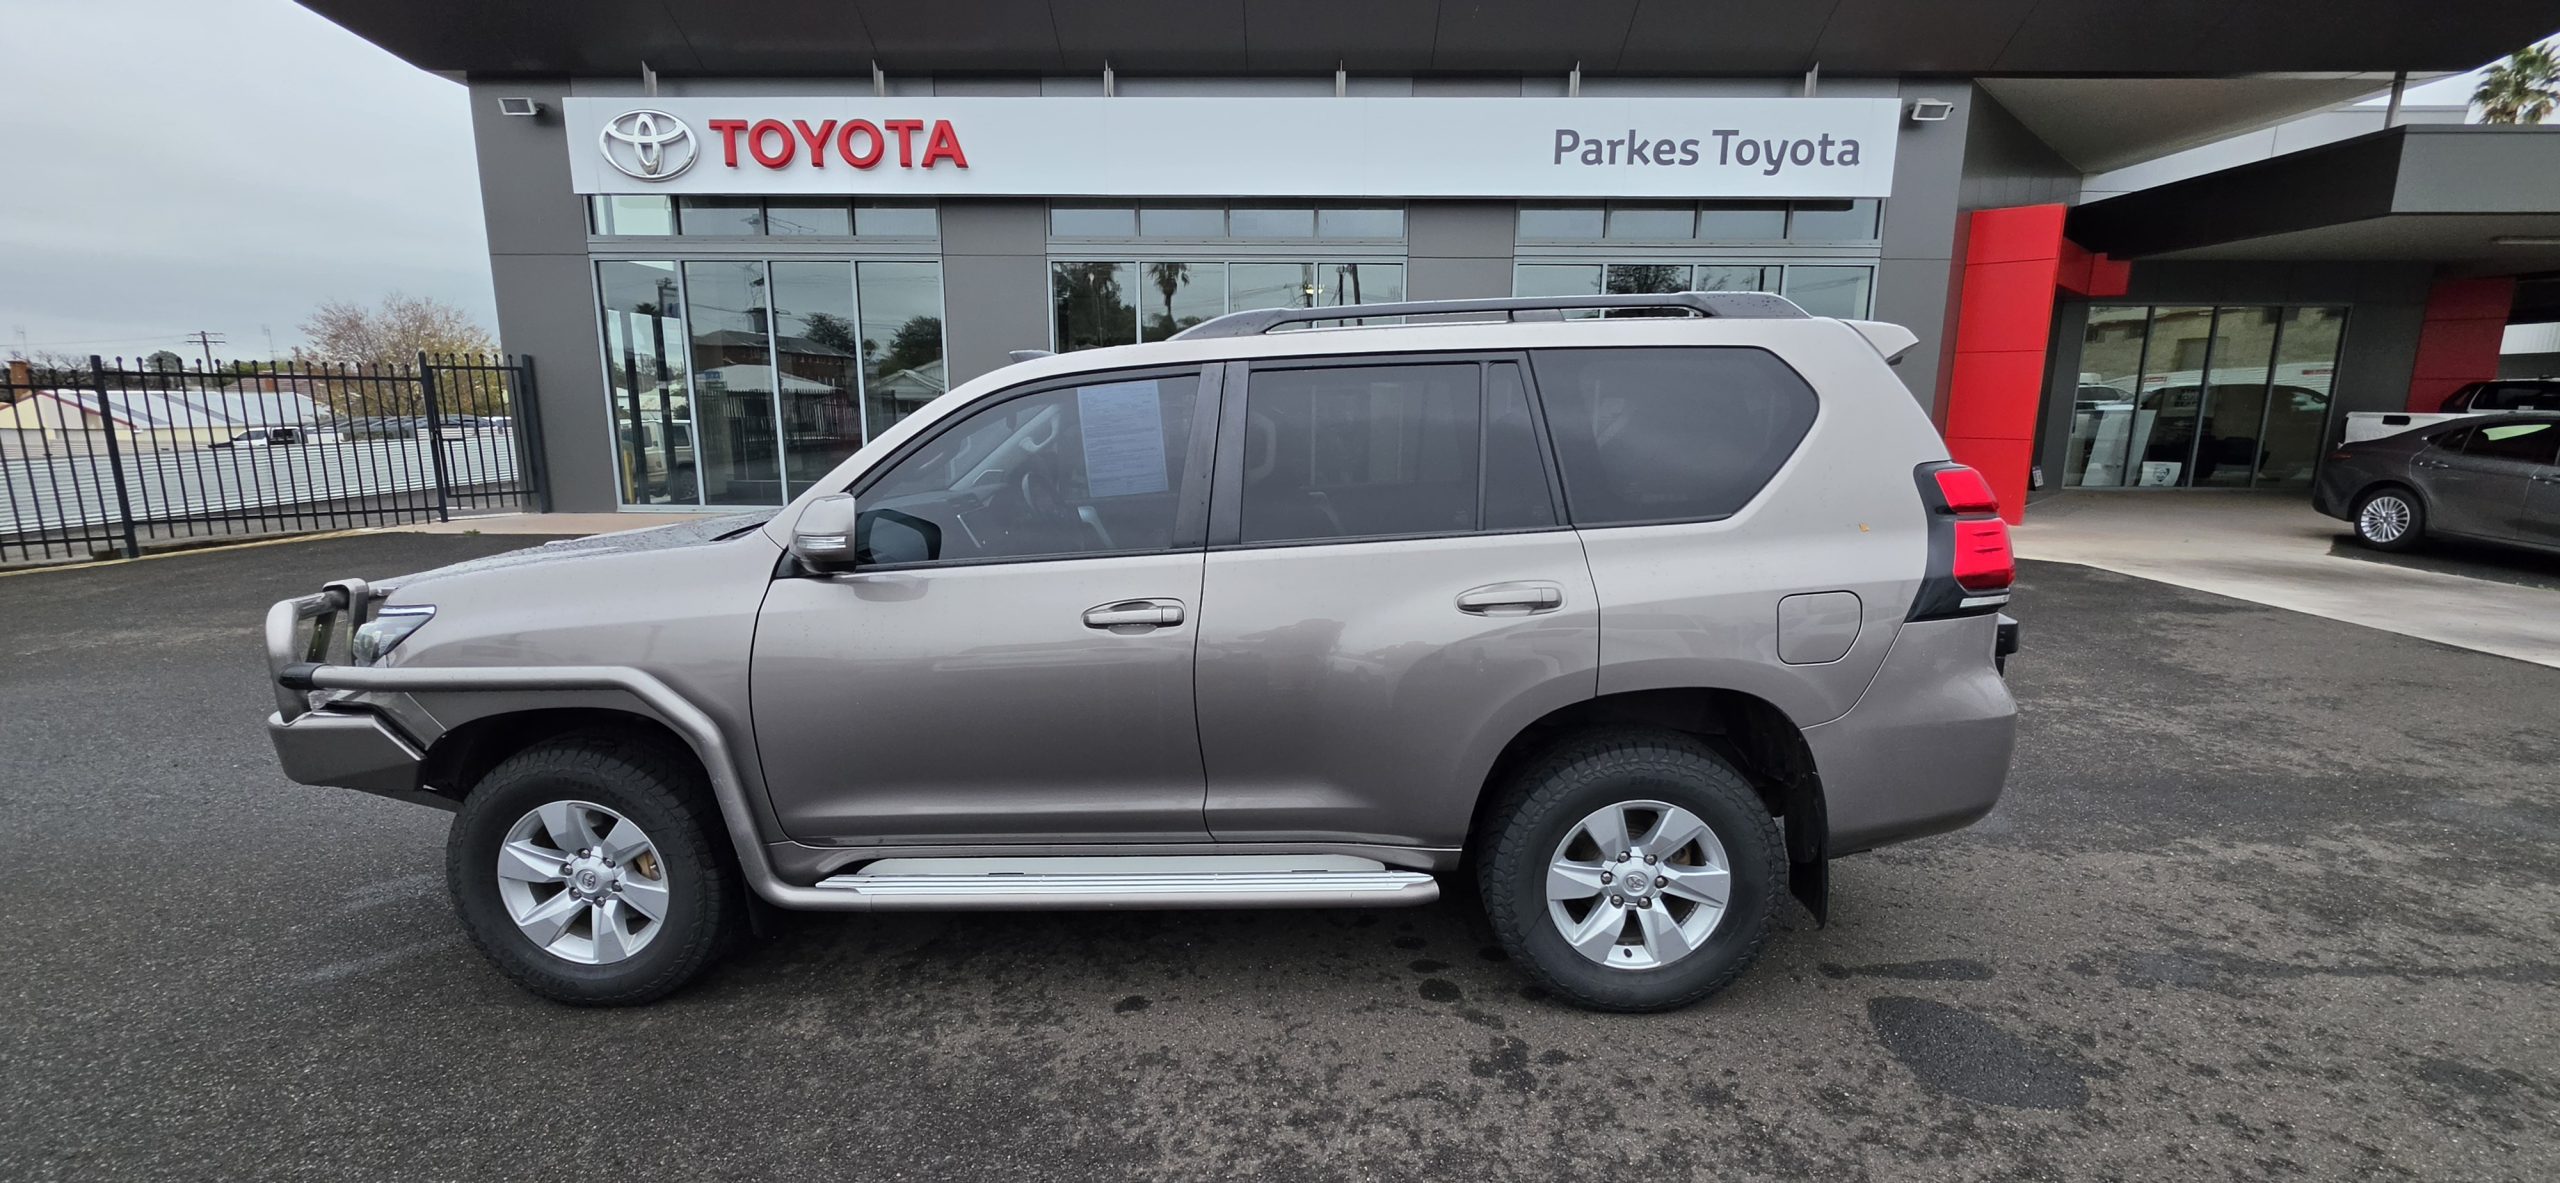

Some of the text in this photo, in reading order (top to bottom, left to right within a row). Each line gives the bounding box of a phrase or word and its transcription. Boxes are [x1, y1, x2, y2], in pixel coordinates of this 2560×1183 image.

[708, 118, 969, 169] TOYOTA
[1553, 129, 1861, 176] Parkes Toyota
